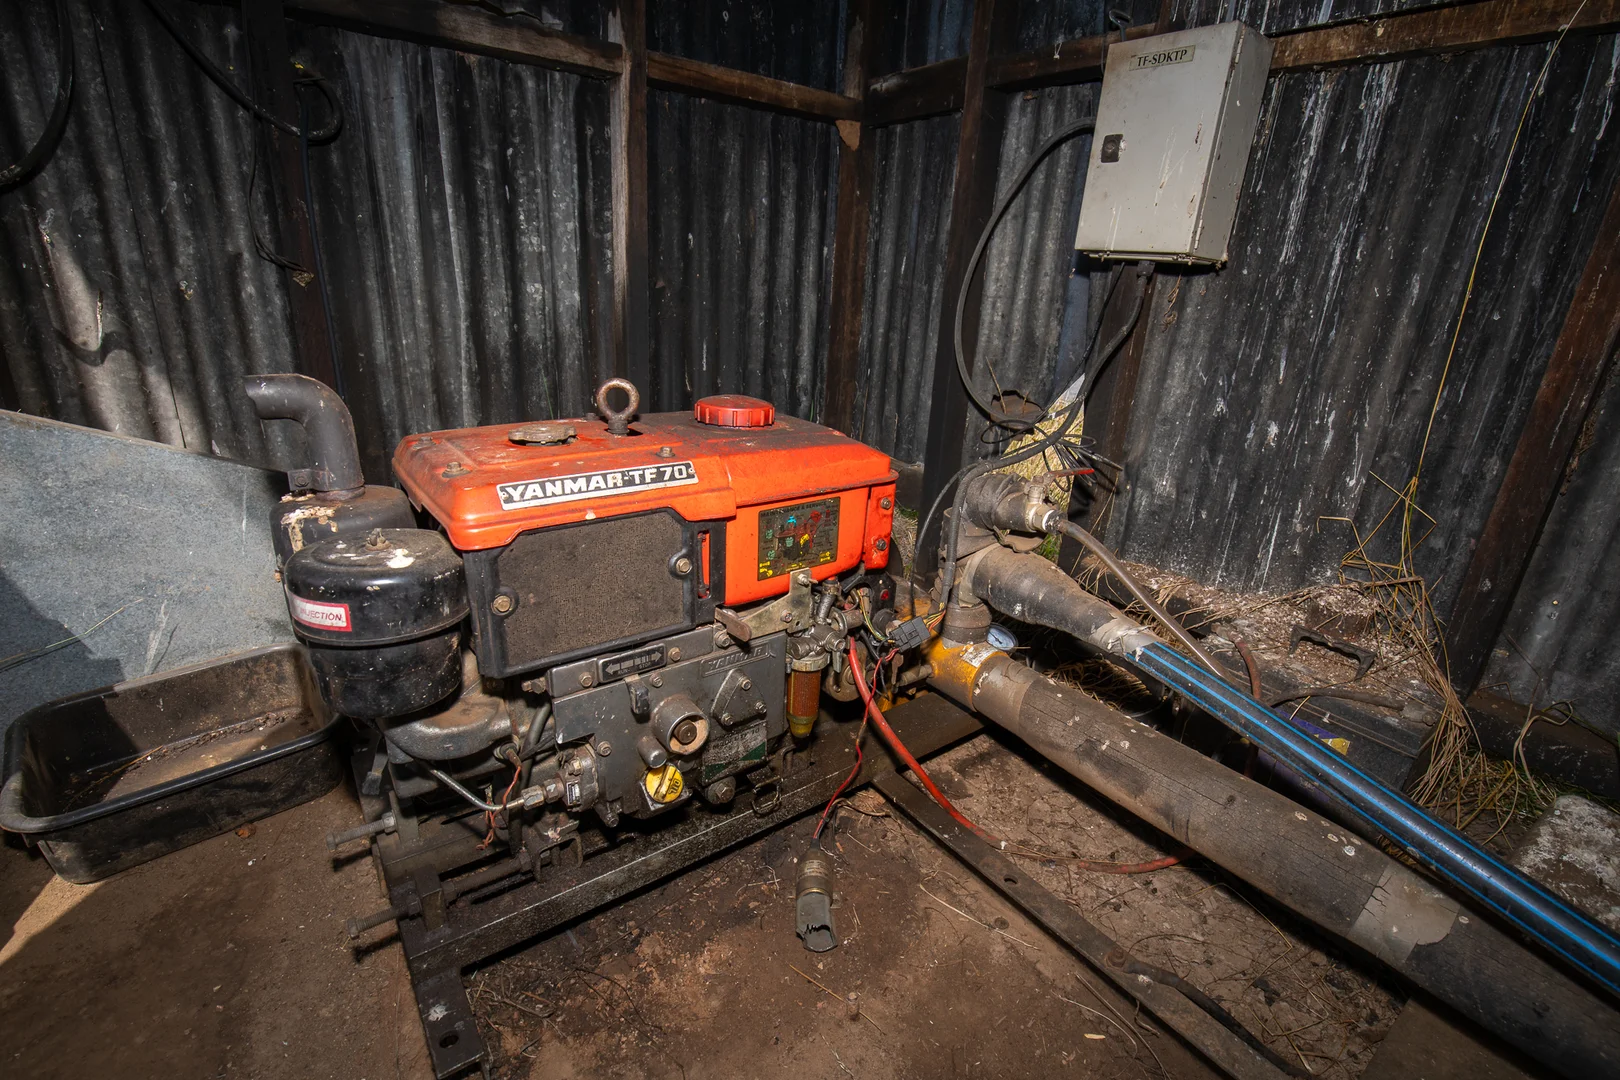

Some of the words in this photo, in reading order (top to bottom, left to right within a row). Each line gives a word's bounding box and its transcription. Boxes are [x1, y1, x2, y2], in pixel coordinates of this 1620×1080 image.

[1137, 49, 1188, 67] TF-SDKTP
[662, 464, 688, 481] 70
[668, 778, 681, 795] OIL
